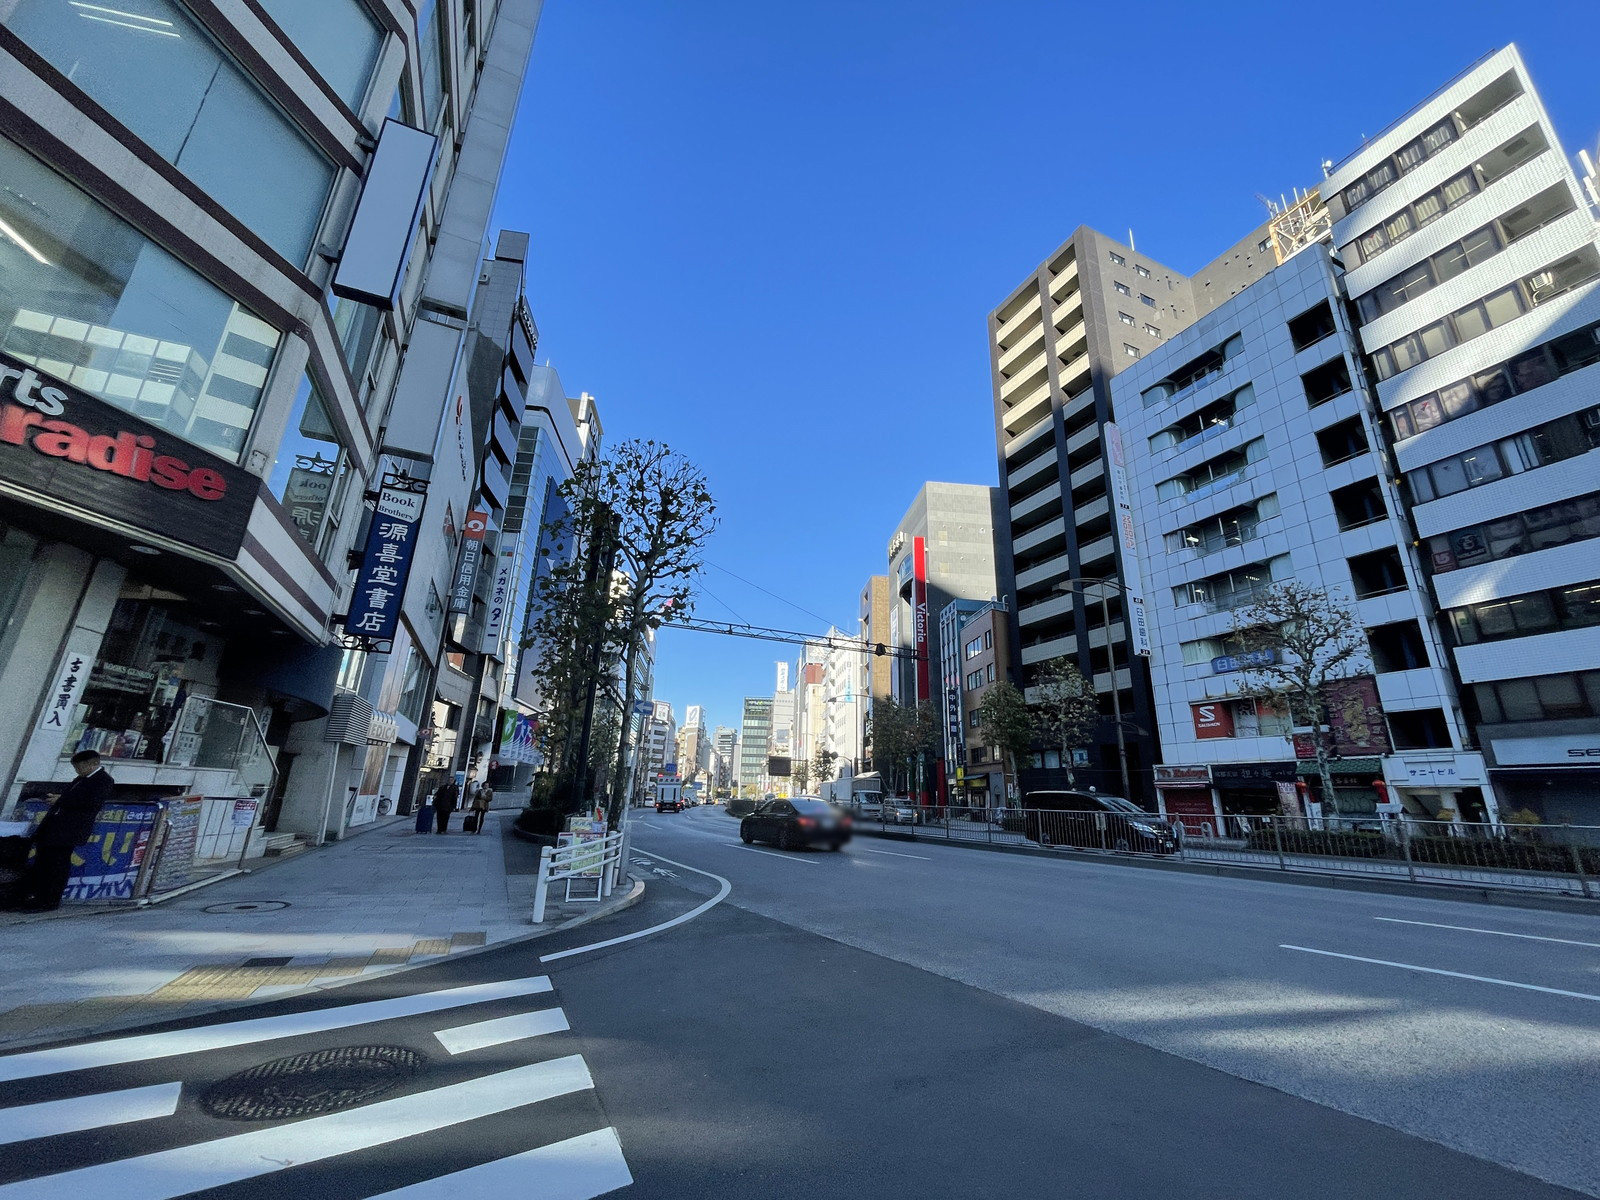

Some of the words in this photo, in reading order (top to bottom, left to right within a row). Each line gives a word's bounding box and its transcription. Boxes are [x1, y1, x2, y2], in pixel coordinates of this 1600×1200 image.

[378, 504, 414, 521] Brothers
[382, 492, 415, 508] Book
[355, 522, 409, 632] 源喜堂書店
[452, 539, 480, 610] 朝日信用金庫
[916, 602, 926, 643] Victoria
[47, 657, 84, 727] 古書買入
[1408, 767, 1457, 777] サニービル
